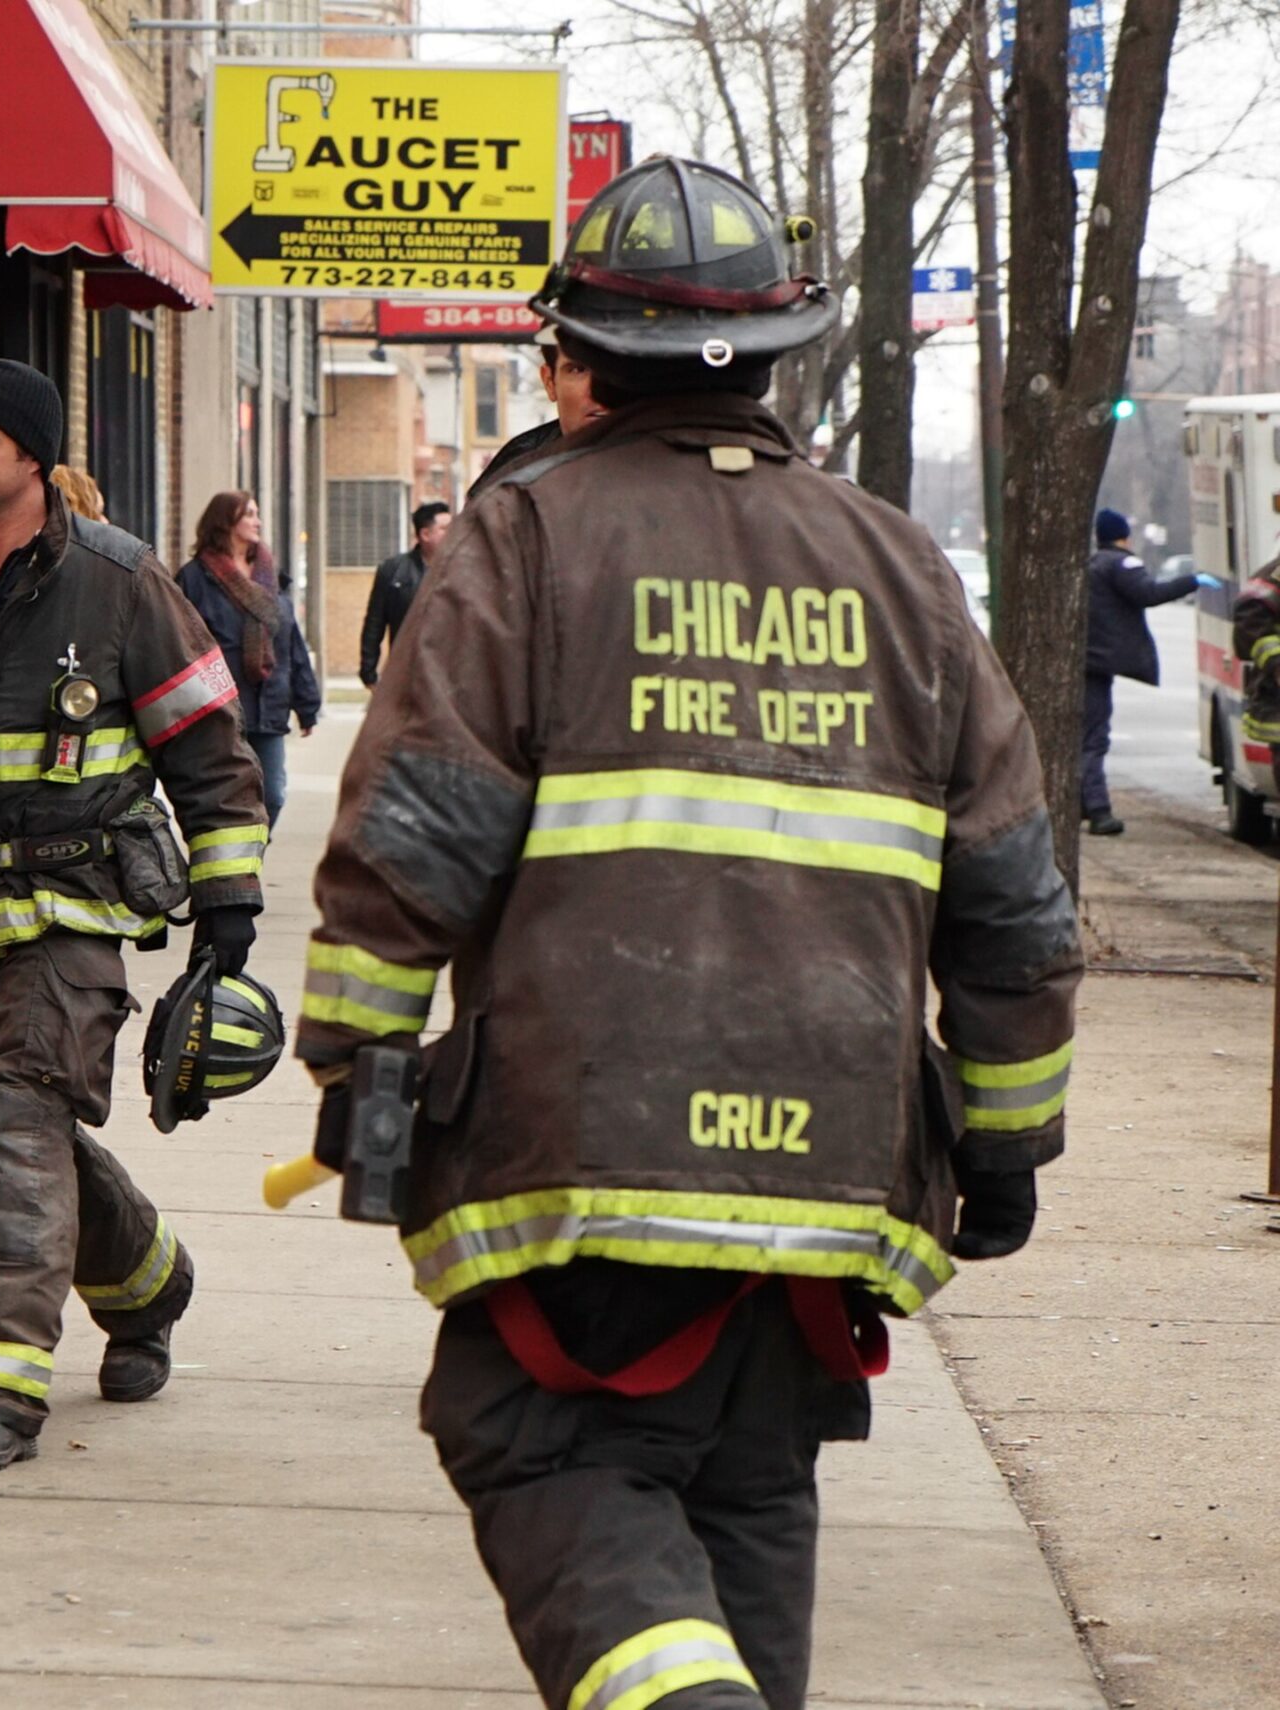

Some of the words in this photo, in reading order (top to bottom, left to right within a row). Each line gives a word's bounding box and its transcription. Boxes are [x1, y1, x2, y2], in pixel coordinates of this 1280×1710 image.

[371, 97, 439, 120] THE
[343, 178, 475, 212] GUY
[304, 220, 351, 232] SALES
[354, 220, 418, 233] SERVICE
[434, 222, 498, 235] REPAIRS
[279, 232, 381, 245] SPECIALIZING
[384, 234, 401, 246] IN
[403, 234, 471, 248] GENUINE
[473, 236, 522, 249] PARTS
[281, 246, 312, 258] FOR
[314, 247, 341, 258] ALL
[343, 248, 385, 259] YOUR
[388, 248, 465, 261] PLUMBING
[467, 249, 519, 262] NEEDS
[280, 266, 516, 289] 773-227-8445
[423, 307, 542, 327] 384-89
[634, 577, 868, 667] CHICAGO
[630, 676, 738, 738] FIRE
[758, 690, 874, 748] DEPT
[689, 1090, 812, 1154] CRUZ
